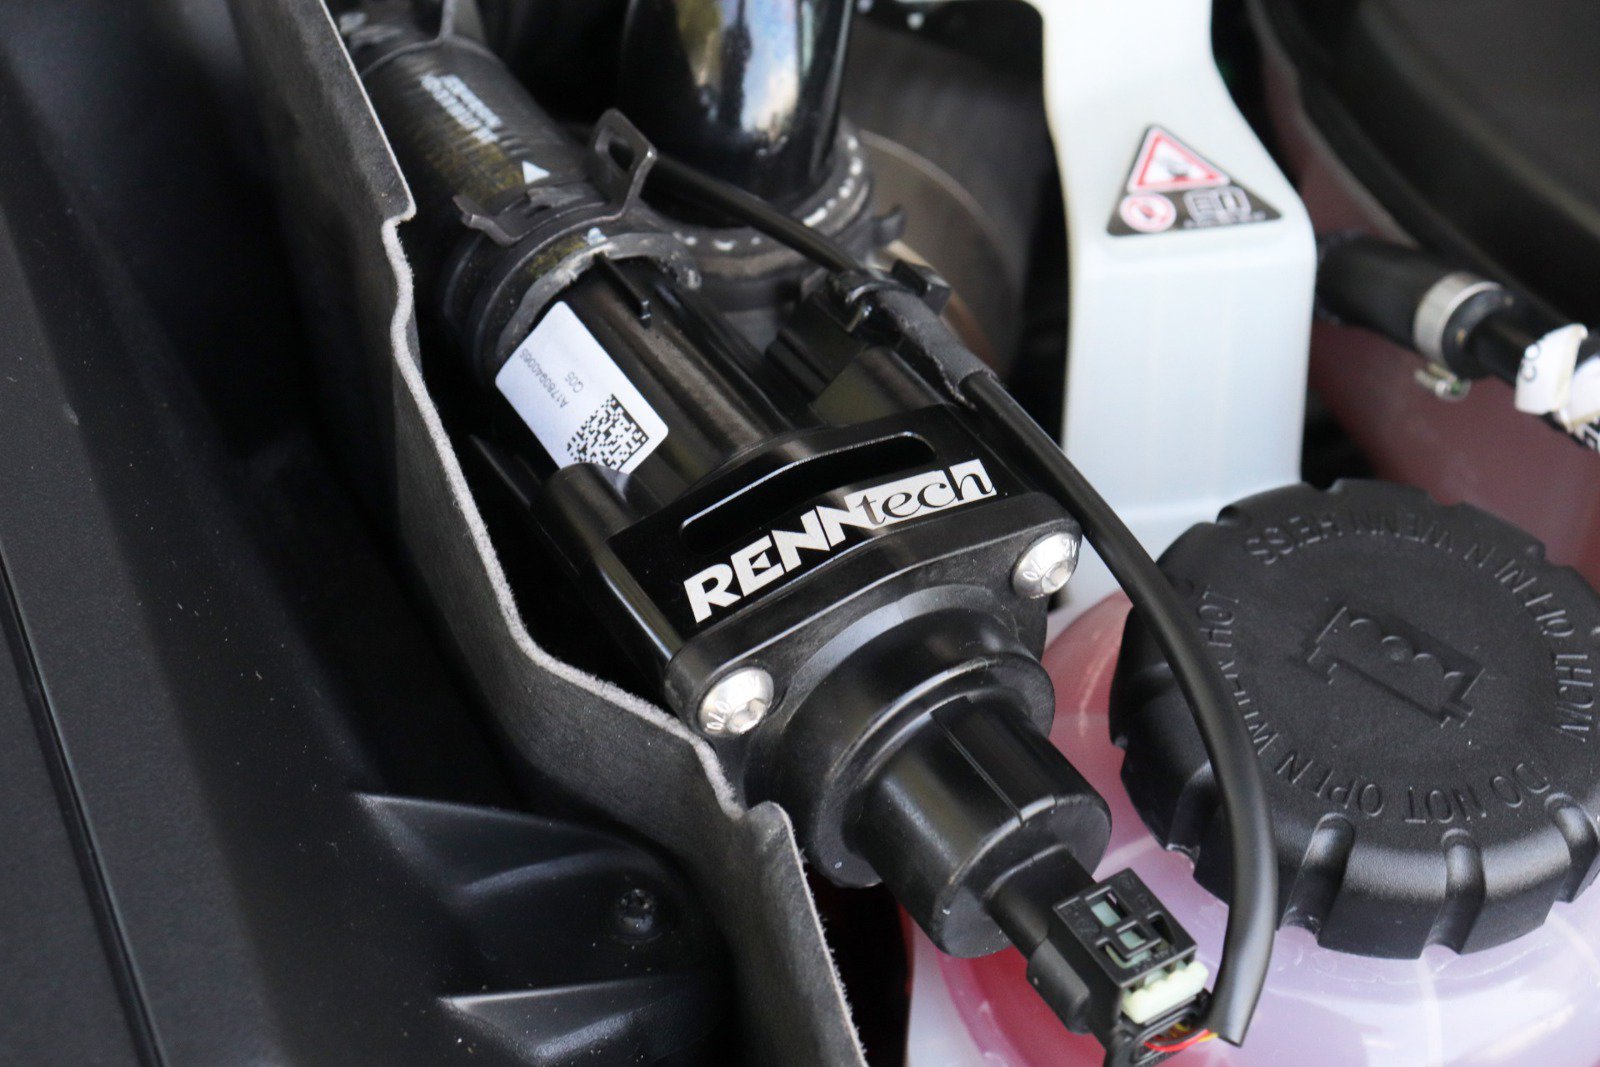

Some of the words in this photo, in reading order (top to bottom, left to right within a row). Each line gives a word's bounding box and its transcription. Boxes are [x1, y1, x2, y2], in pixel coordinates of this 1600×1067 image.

[683, 458, 997, 624] RENNtech
[1404, 780, 1489, 824] NOT
[1489, 762, 1552, 809] DO
